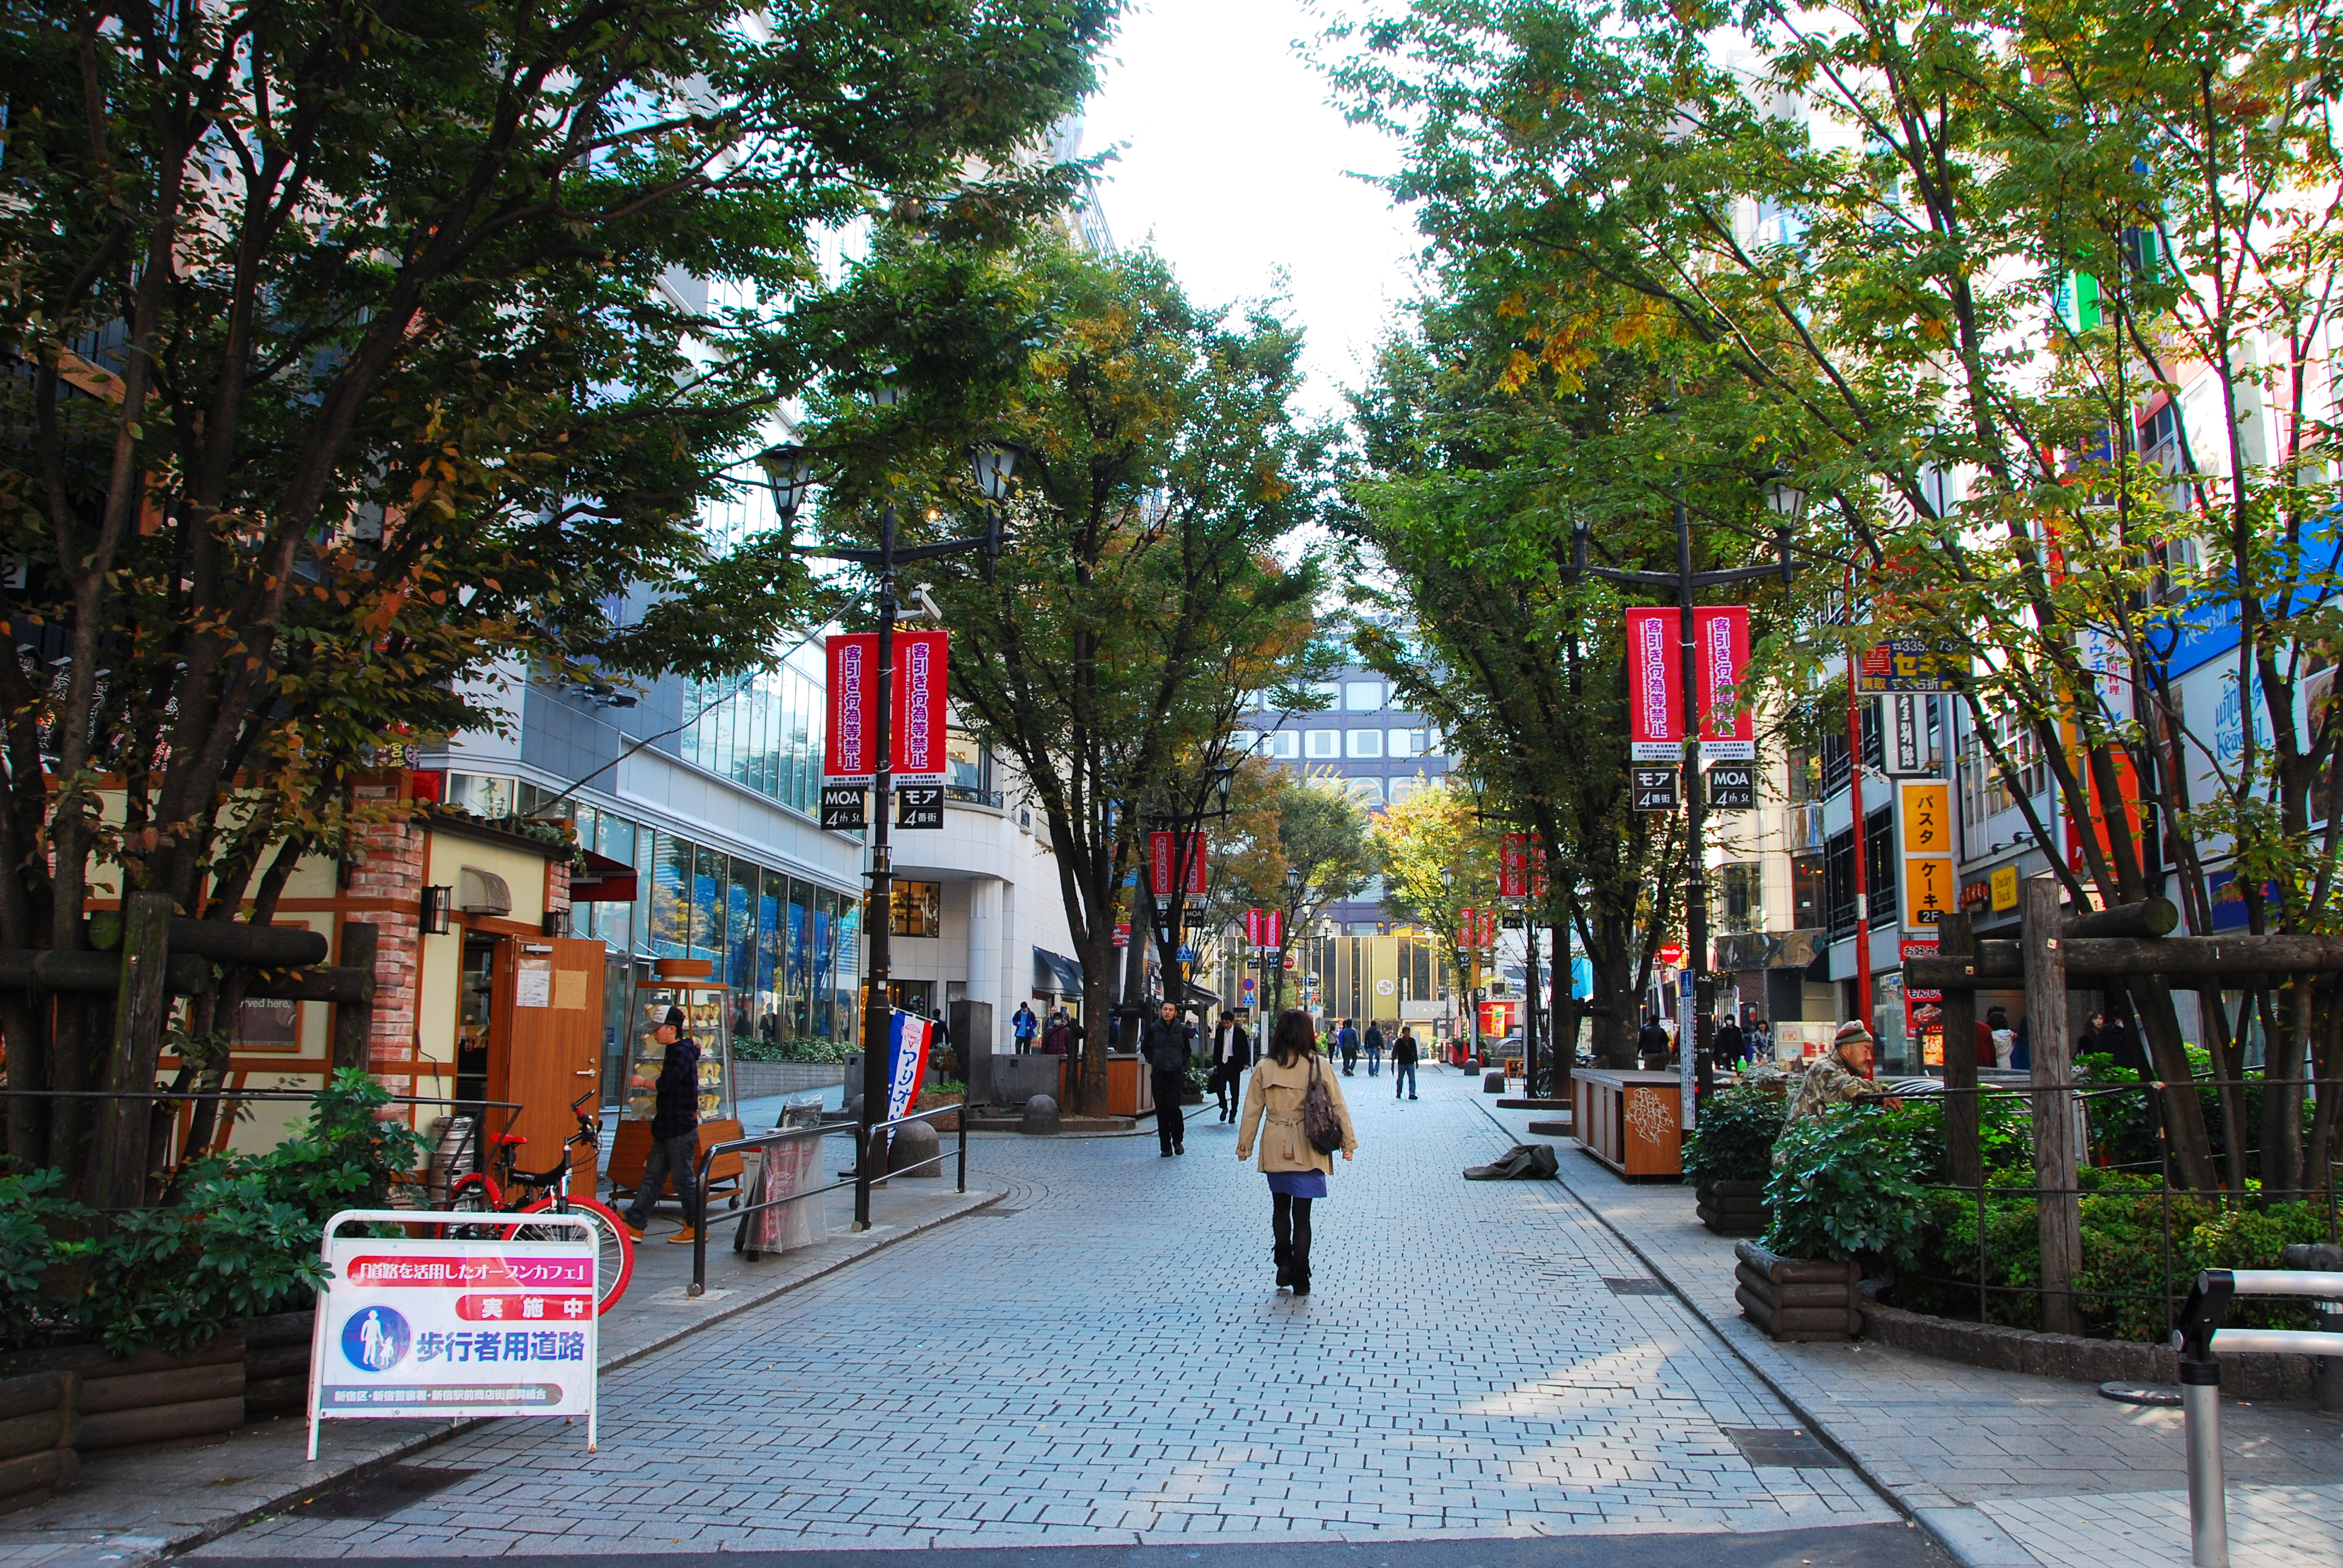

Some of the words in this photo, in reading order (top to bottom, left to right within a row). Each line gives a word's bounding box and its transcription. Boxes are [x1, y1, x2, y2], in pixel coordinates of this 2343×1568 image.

[1645, 617, 1668, 739] 客引き行為等禁止
[1861, 678, 1886, 690] 買取
[844, 644, 862, 771] 客引き行為等禁止
[909, 642, 929, 769] 客引き行為等禁止
[1639, 773, 1670, 786] モア
[1714, 772, 1749, 786] MOA
[825, 791, 860, 805] MOA
[905, 790, 937, 805] モア
[1639, 791, 1670, 807] 4番街
[1741, 793, 1750, 802] St.
[851, 812, 860, 822] St.
[904, 809, 937, 826] 4番街
[1918, 795, 1933, 845] パスタ
[1922, 861, 1938, 908] ケーキ
[1922, 911, 1939, 922] 2F
[267, 998, 290, 1008] here.
[416, 1331, 585, 1362] 歩行者用道路
